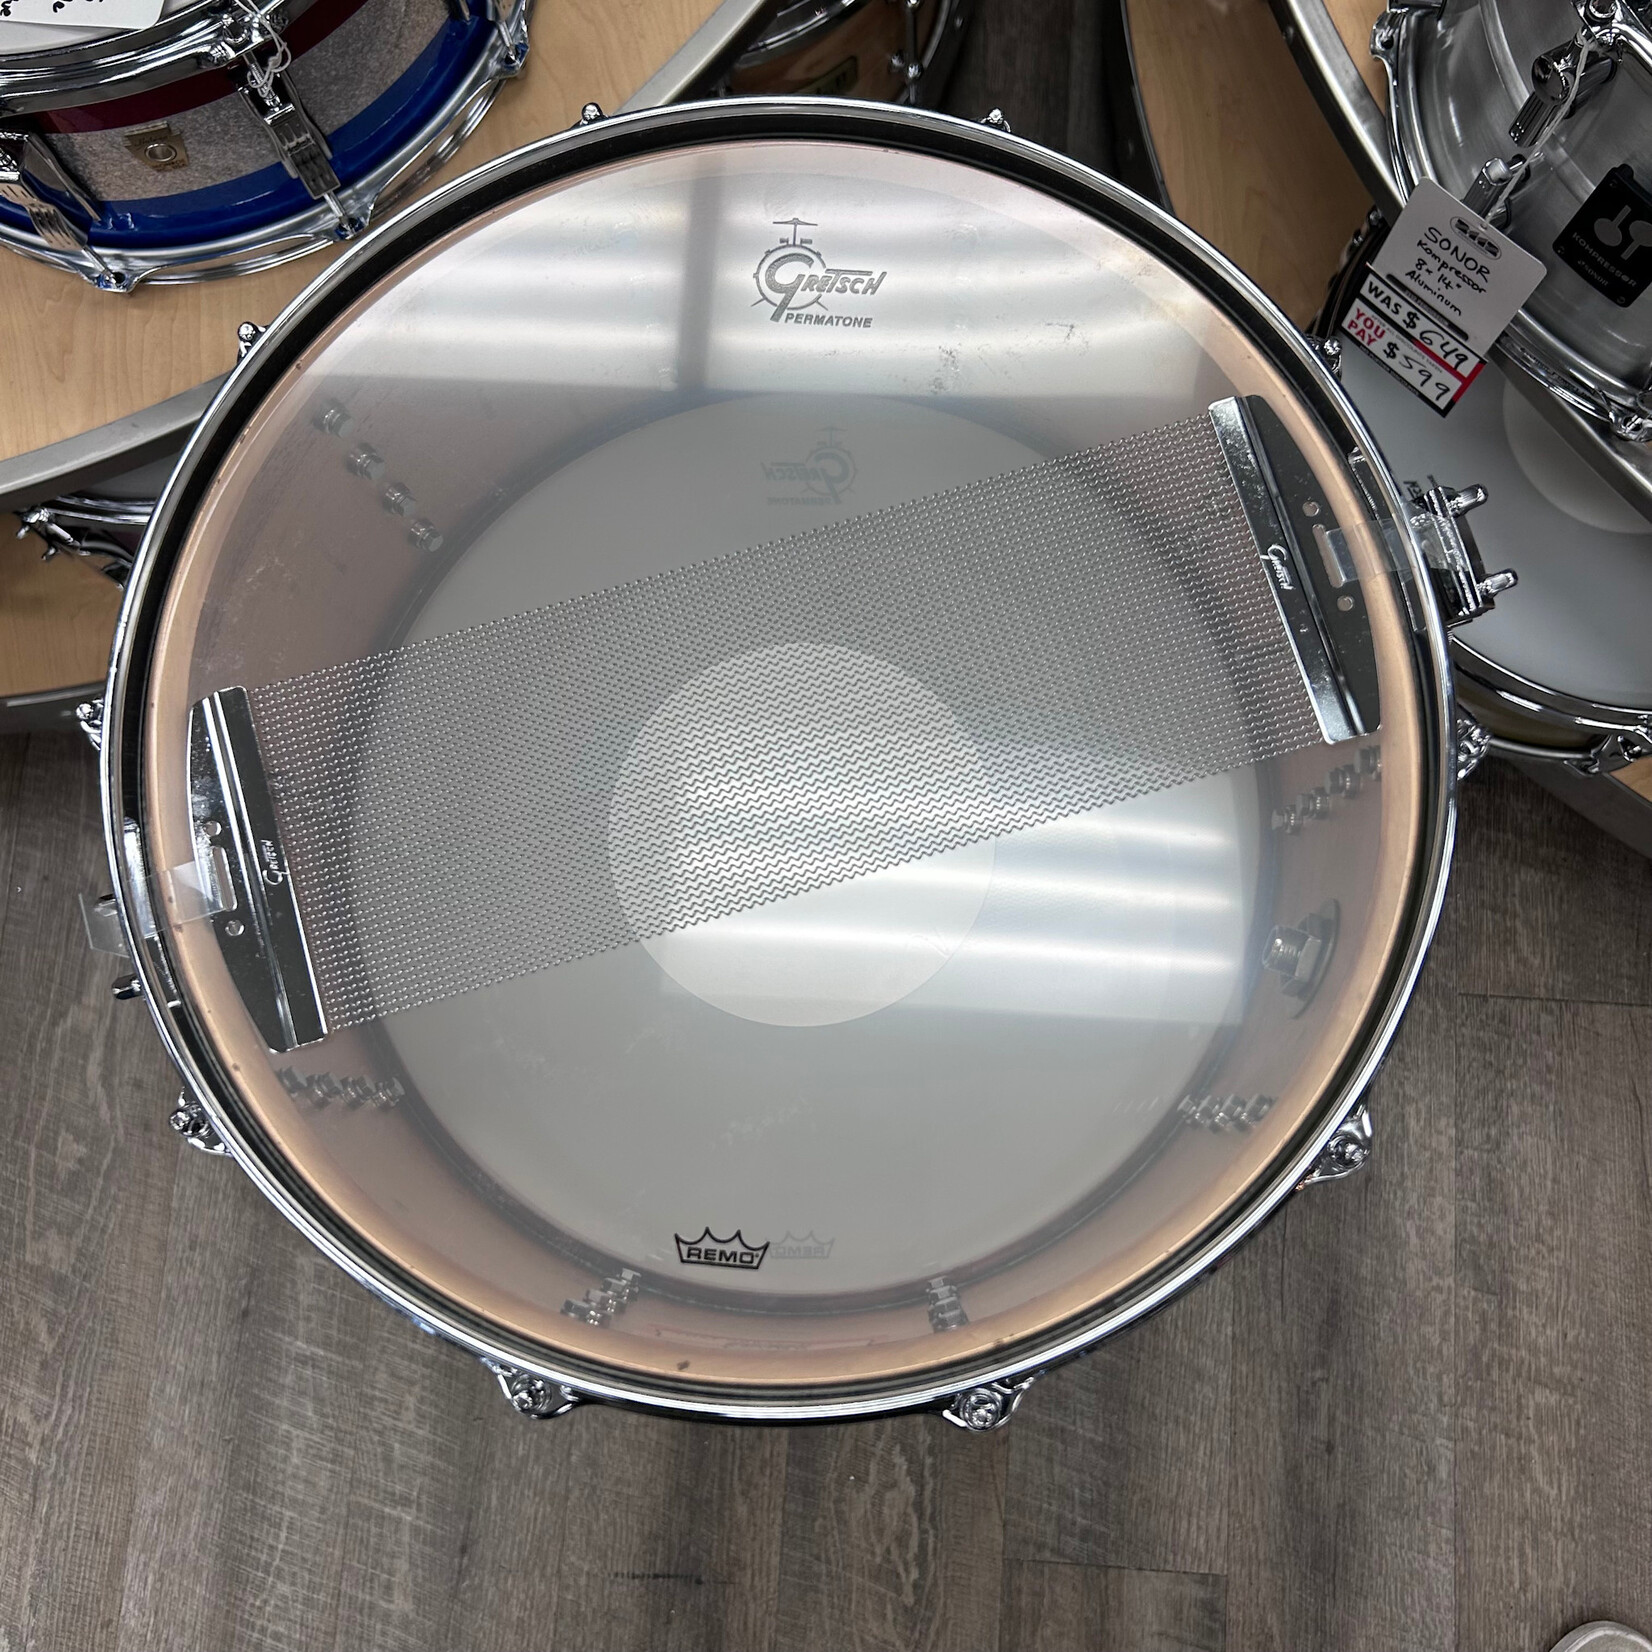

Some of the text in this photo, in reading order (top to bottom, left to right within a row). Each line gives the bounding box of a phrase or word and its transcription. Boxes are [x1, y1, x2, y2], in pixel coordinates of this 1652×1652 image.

[1417, 240, 1487, 293] Kompressor
[1424, 227, 1490, 283] SONOR
[1572, 232, 1637, 287] KOMPRESSOR
[1368, 281, 1402, 315] WAS
[1405, 270, 1462, 316] Aluminum
[784, 313, 873, 328] PERMATONE
[1347, 320, 1376, 346] PAY
[1356, 308, 1386, 339] YOU
[687, 1246, 755, 1265] REMO
